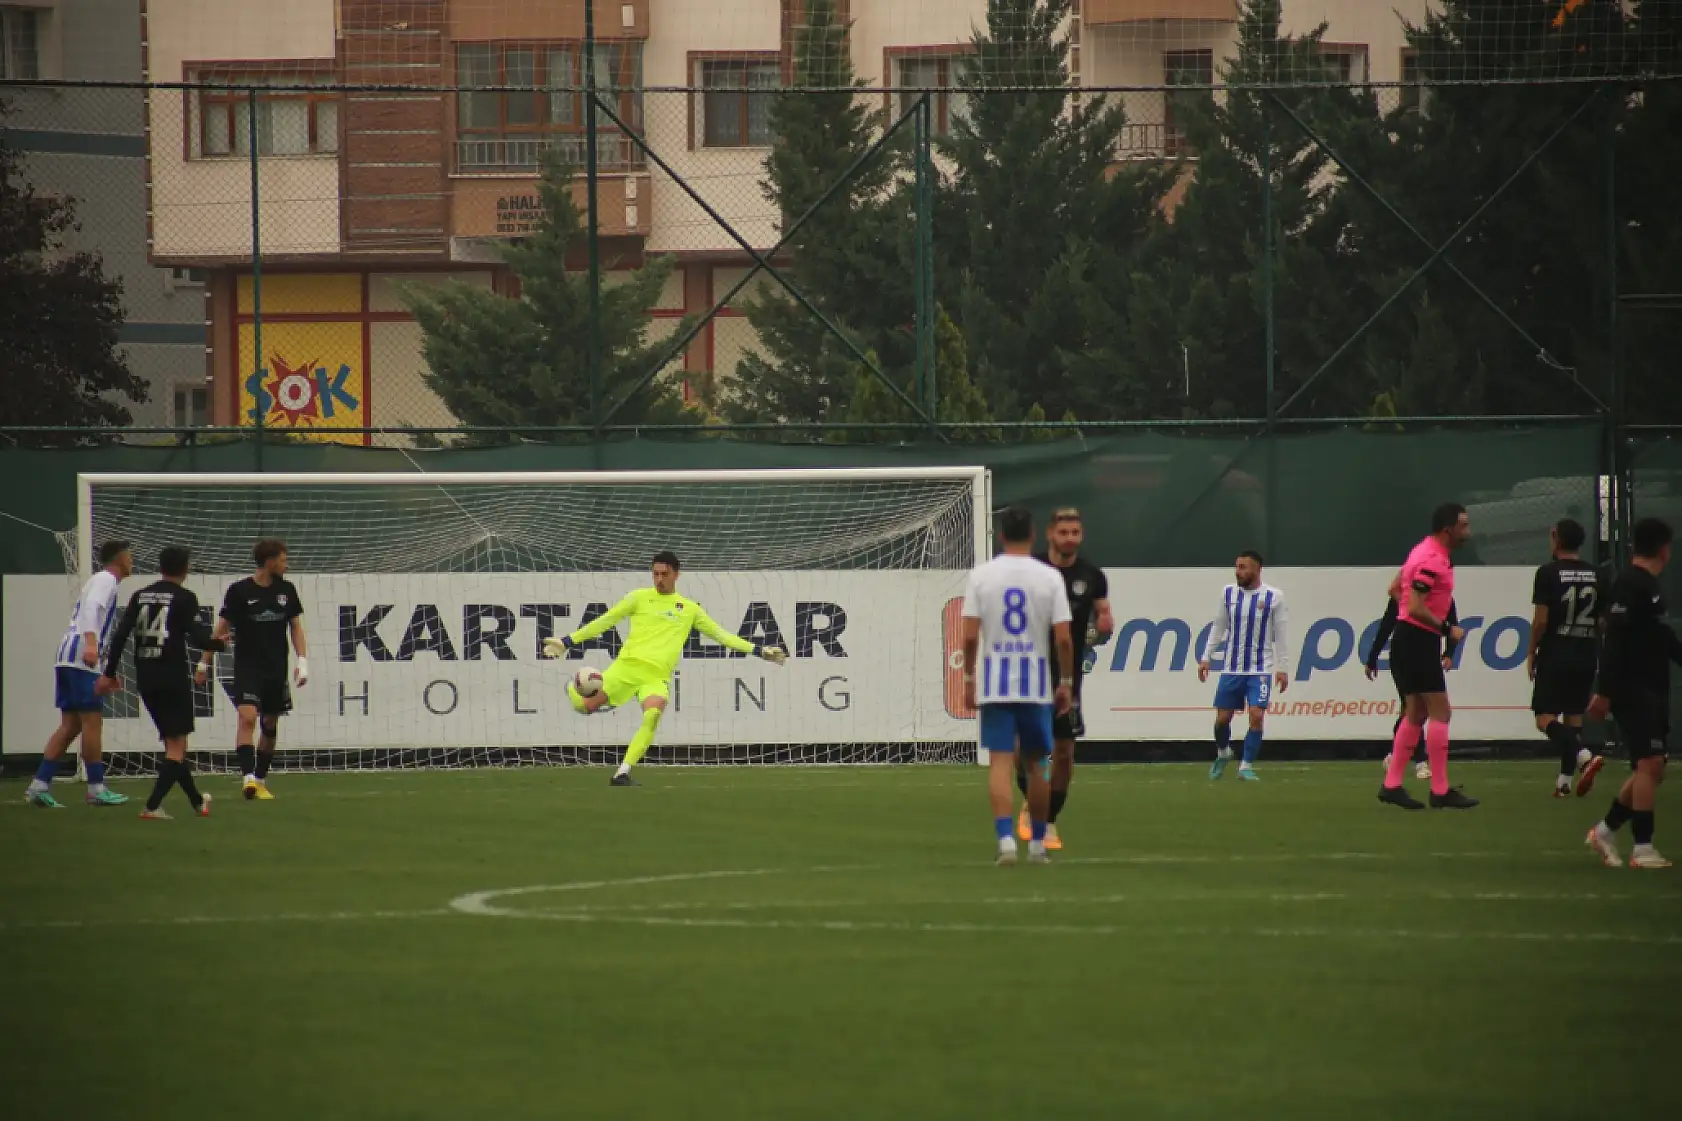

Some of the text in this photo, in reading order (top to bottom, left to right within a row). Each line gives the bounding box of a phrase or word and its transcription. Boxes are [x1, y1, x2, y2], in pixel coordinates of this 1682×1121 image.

[137, 604, 169, 646] 44
[1003, 588, 1027, 635] 8
[1560, 586, 1597, 625] 12
[338, 602, 849, 661] KARTALAR
[338, 670, 851, 716] HOLİNG
[1259, 684, 1268, 698] 9
